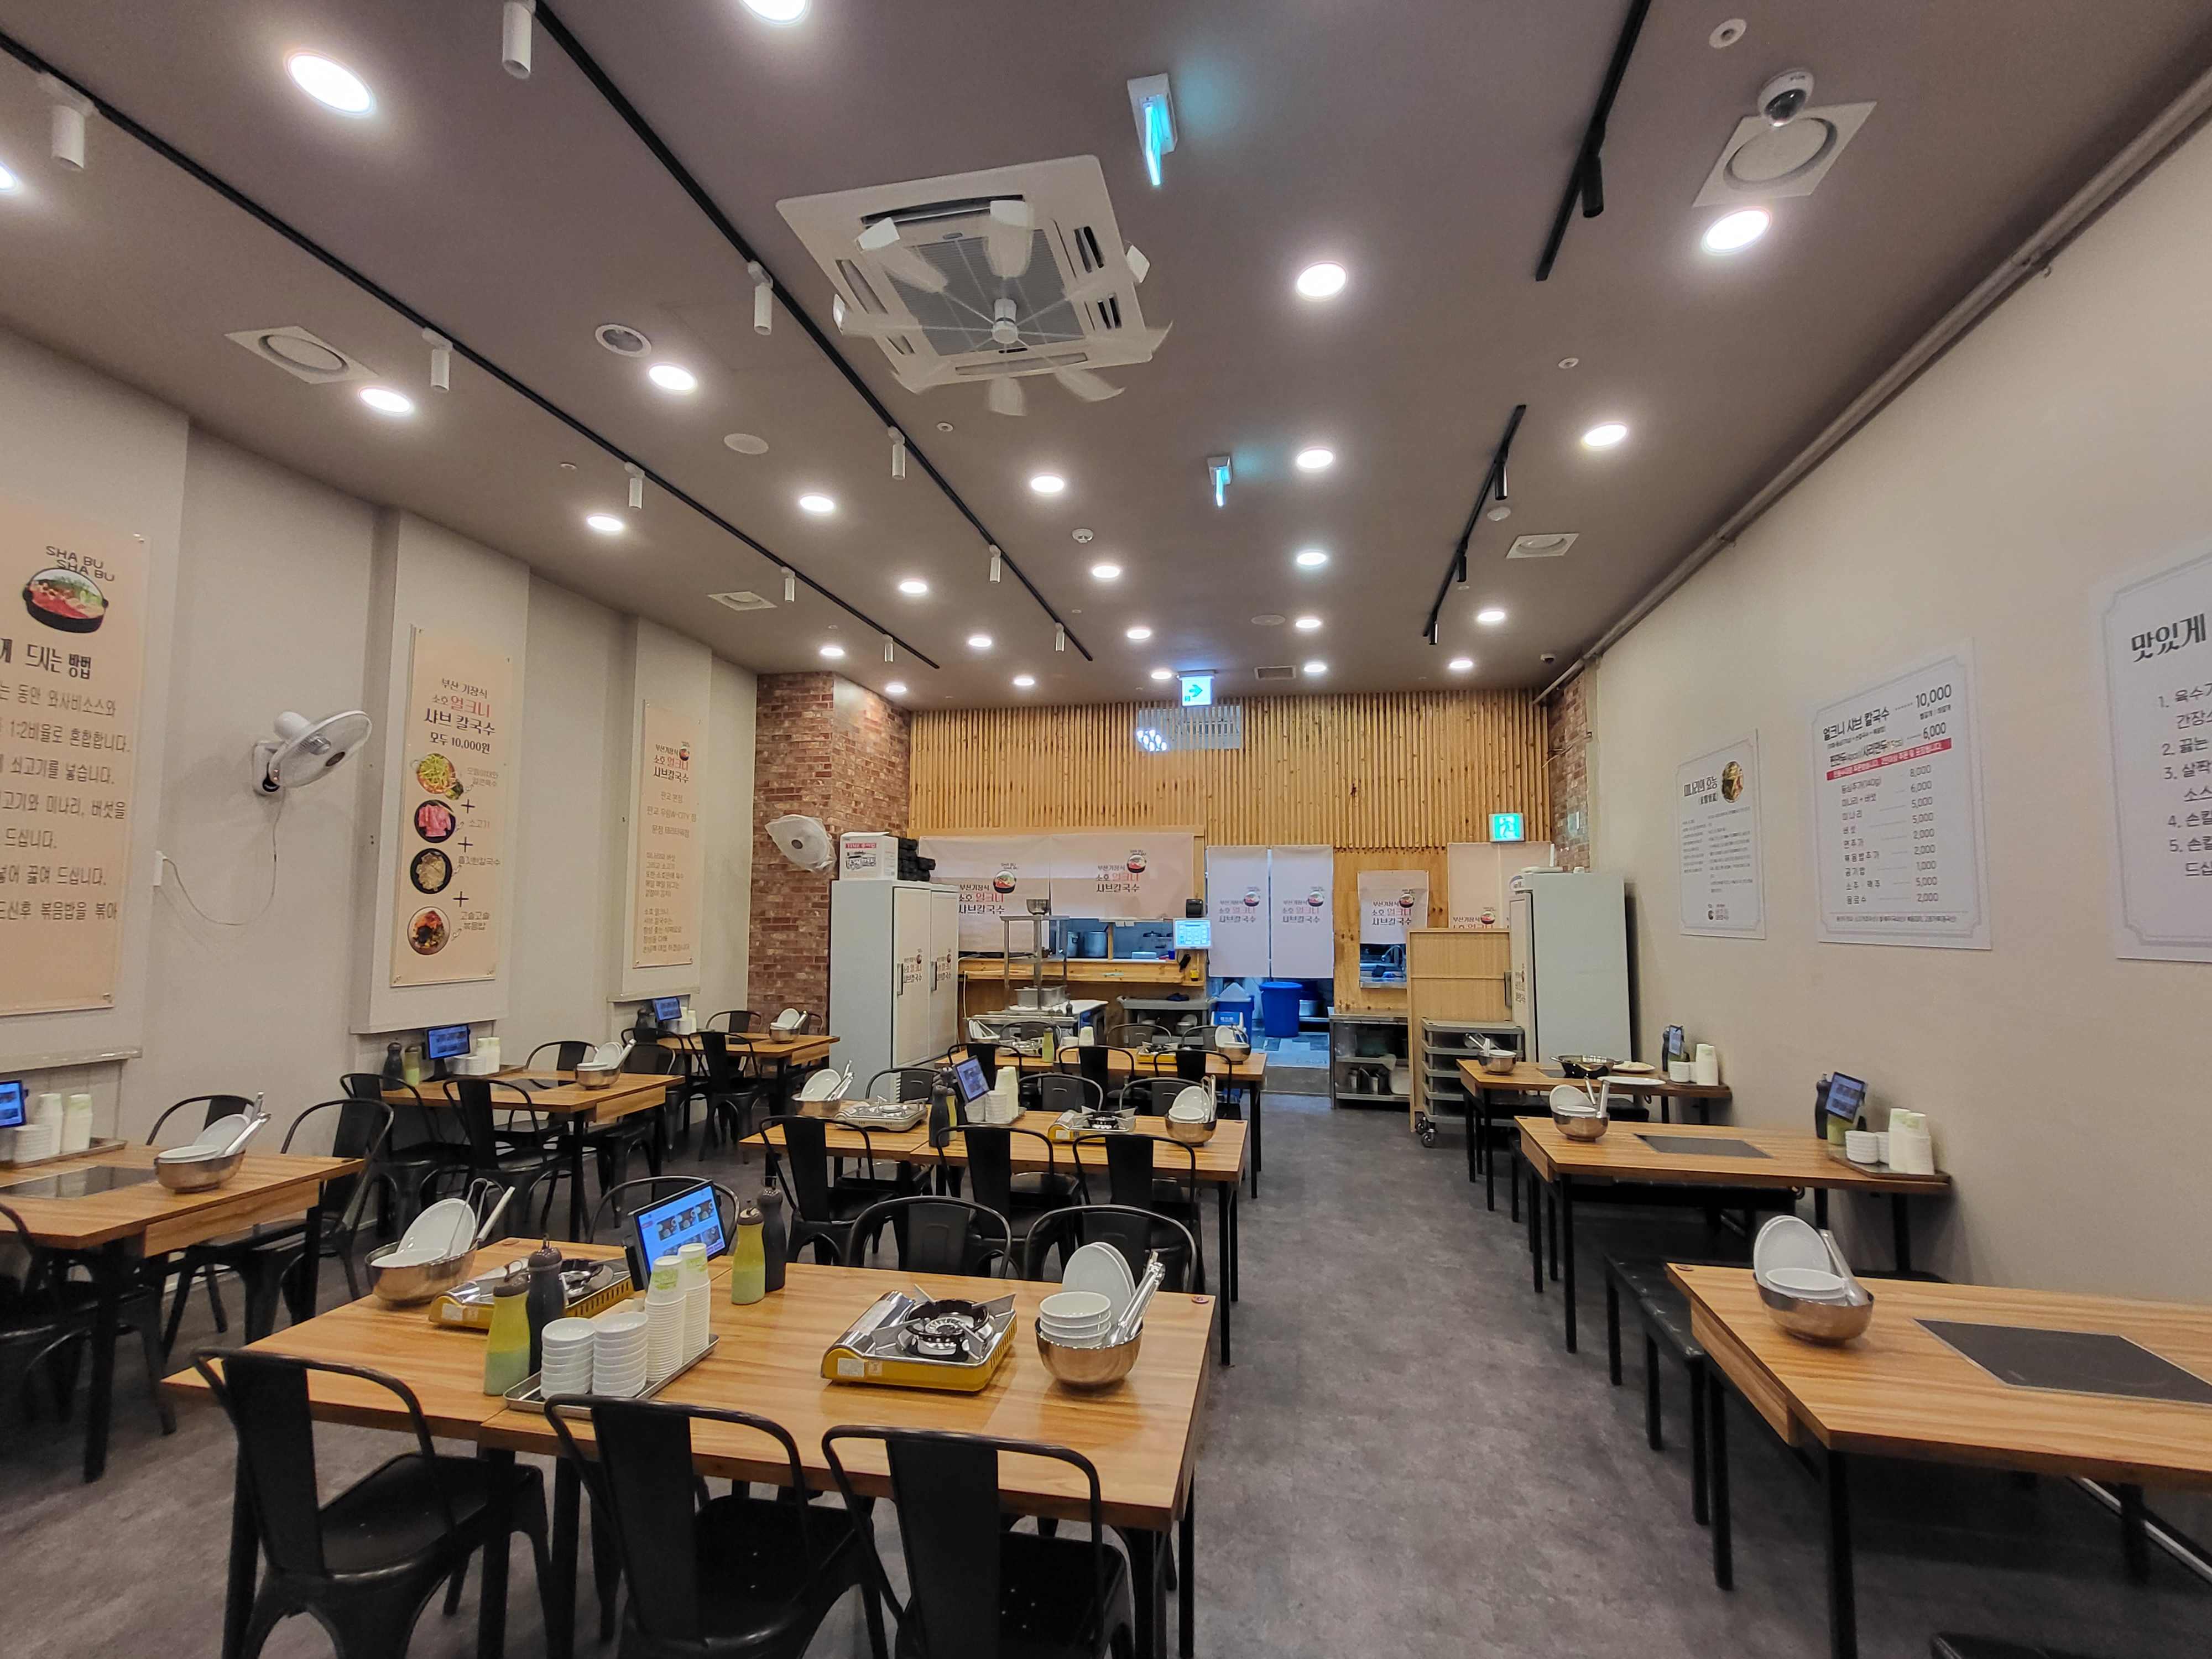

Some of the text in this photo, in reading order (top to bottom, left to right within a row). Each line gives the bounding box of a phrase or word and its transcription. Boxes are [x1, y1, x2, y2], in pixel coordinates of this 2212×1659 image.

[46, 546, 103, 568] SHA BU
[56, 559, 114, 582] SHA BU
[2131, 613, 2206, 662] 맛있게
[25, 644, 62, 674] 드시는
[69, 653, 91, 680] 방법
[442, 678, 487, 699] 부산 기장식
[18, 684, 40, 705] 동안
[48, 690, 116, 717] 와사비소스와
[451, 695, 490, 718] 얼크니
[424, 707, 495, 736] 샤브 칼국수
[1823, 721, 1845, 741] 얼크니
[1847, 715, 1863, 732] 샤브
[1864, 706, 1890, 727] 칼국수
[1916, 684, 1952, 708] 10,000
[1923, 722, 1947, 740] 6,000
[70, 728, 131, 753] 혼합합니다.
[430, 732, 491, 755] 모두 10,000원
[2162, 737, 2208, 755] 2. 끓는
[10, 755, 59, 779] 쇠고기를
[66, 762, 114, 784] 넣습니다.
[1910, 765, 1931, 777] 8,000
[2164, 766, 2177, 780] 3.
[1684, 776, 1718, 797] 미나리의 효능
[1911, 781, 1932, 792] 6,000
[0, 791, 39, 812] 고기와
[91, 800, 126, 819] 버섯을
[1912, 797, 1933, 808] 5,000
[468, 819, 490, 828] 소고기
[1913, 812, 1933, 823] 5,000
[2168, 815, 2181, 828] 4.
[4, 828, 57, 849] 드십니다.
[1913, 828, 1934, 839] 2,000
[1914, 844, 1936, 855] 2,000
[2169, 839, 2183, 852] 5.
[1916, 860, 1936, 871] 1,000
[56, 867, 106, 885] 드십니다.
[1916, 877, 1937, 886] 5,000
[1917, 893, 1939, 902] 2,000
[40, 901, 87, 920] 볶음밥을
[95, 901, 117, 920] 볶아
